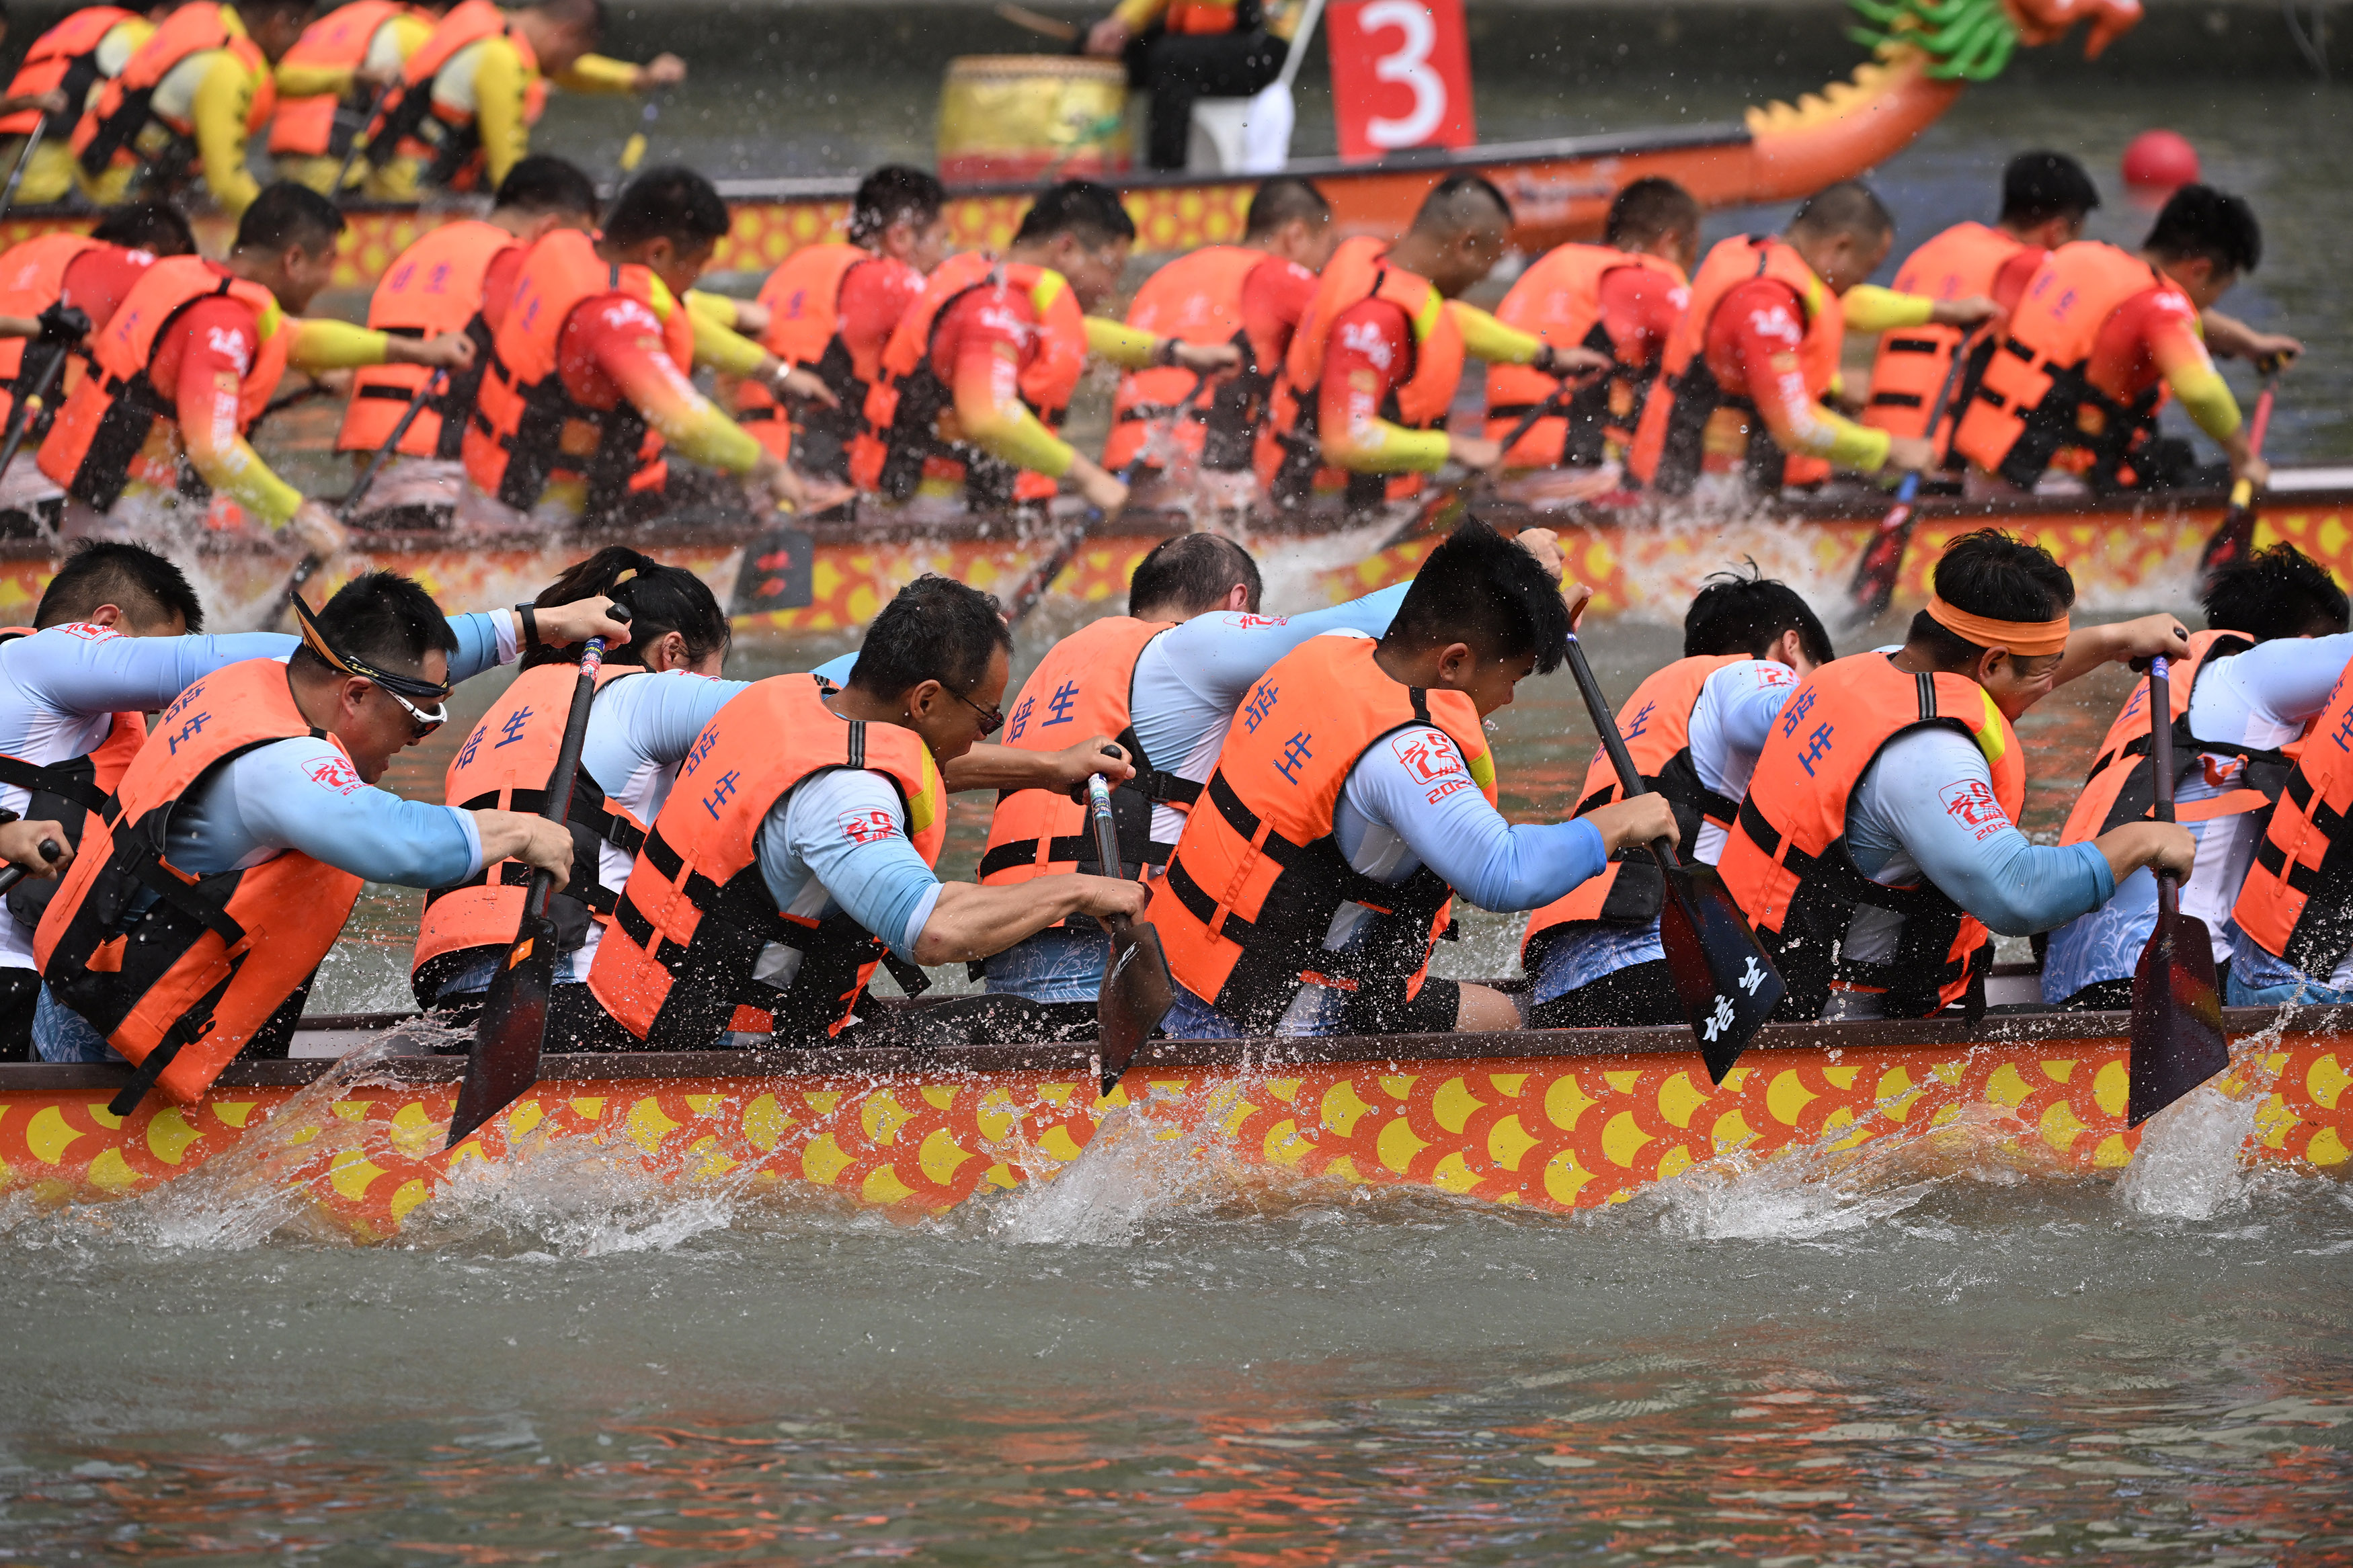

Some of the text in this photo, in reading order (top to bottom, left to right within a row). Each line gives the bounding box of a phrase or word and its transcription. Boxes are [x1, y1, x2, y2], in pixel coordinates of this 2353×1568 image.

[1358, 0, 1447, 149] 3
[454, 705, 534, 771] 培生
[1006, 679, 1080, 745] 培生
